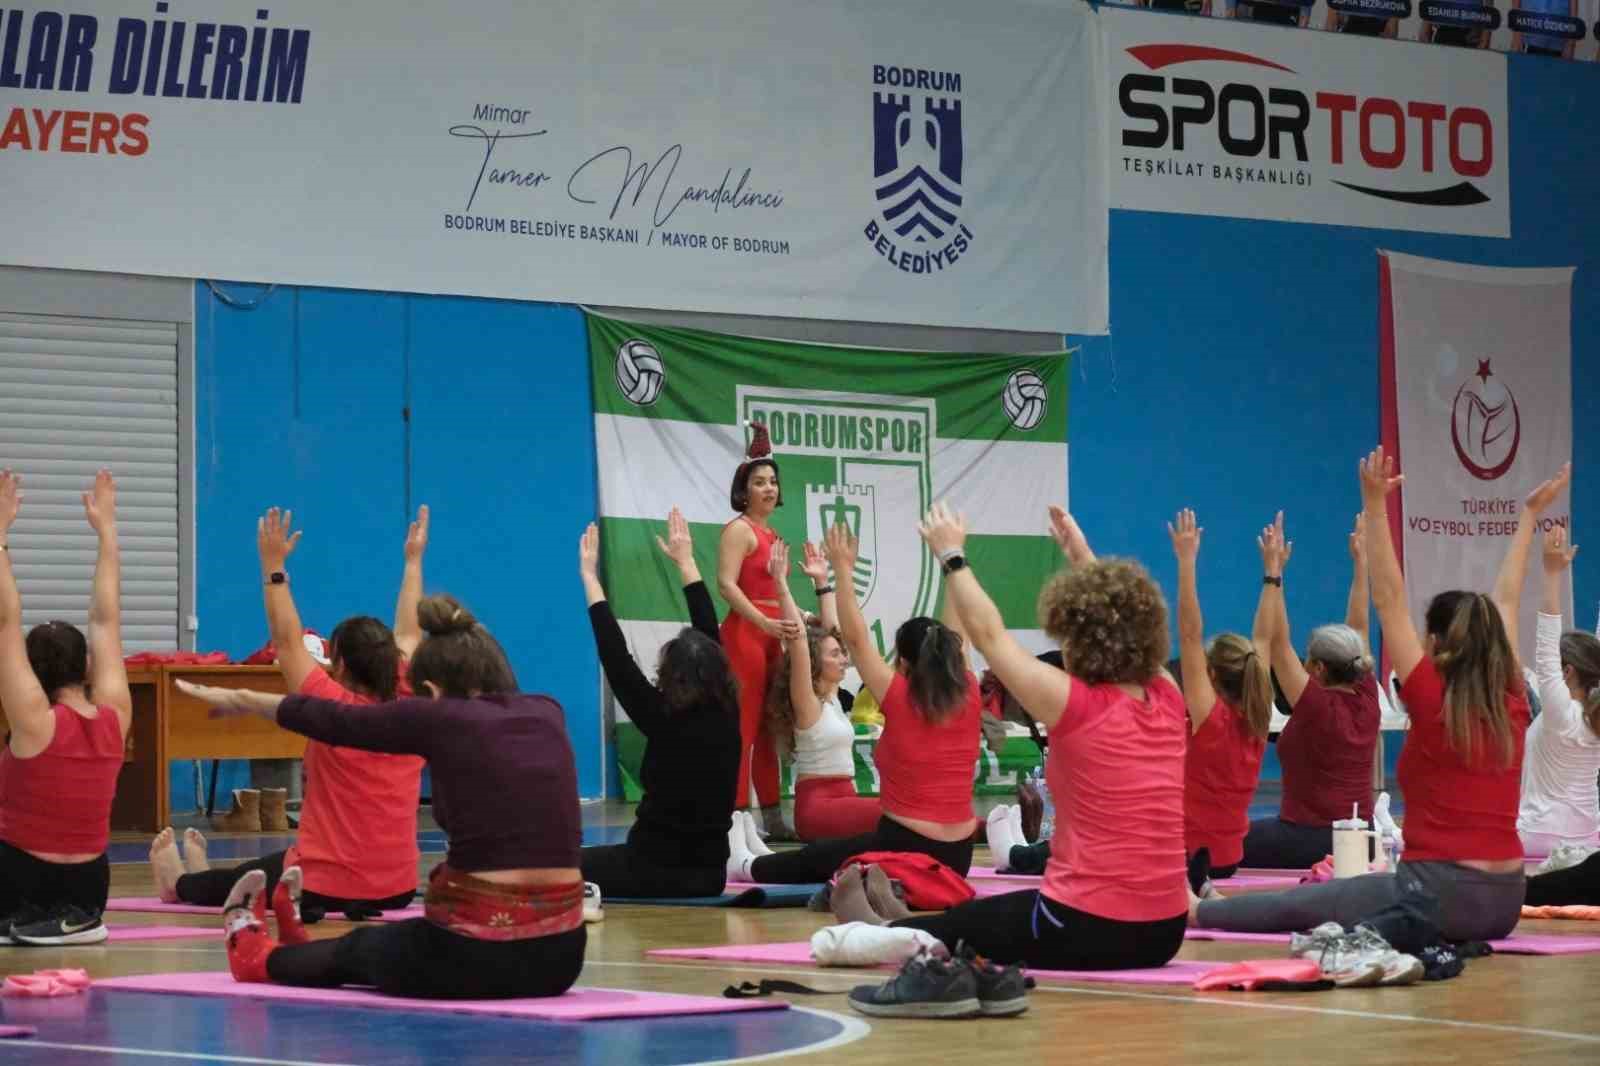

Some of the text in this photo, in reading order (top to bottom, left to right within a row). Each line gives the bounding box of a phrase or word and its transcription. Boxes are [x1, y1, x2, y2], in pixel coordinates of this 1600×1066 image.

[108, 2, 311, 104] DİLERİM
[873, 65, 962, 92] BODRUM
[0, 107, 150, 156] AYERS
[473, 103, 531, 125] Mimar
[449, 125, 551, 212] Tamer
[1122, 157, 1313, 187] TEŞKİLAT BAŞKANLIĞI
[444, 214, 506, 232] BODRUM
[510, 219, 576, 239] BELEDİYE
[579, 225, 639, 243] BAŞKANI
[661, 231, 707, 248] MAYOR
[711, 236, 729, 250] OF
[733, 238, 790, 254] BODRUM
[863, 219, 974, 274] BELEDİYESİ
[1461, 497, 1516, 514] TÜRKİYE
